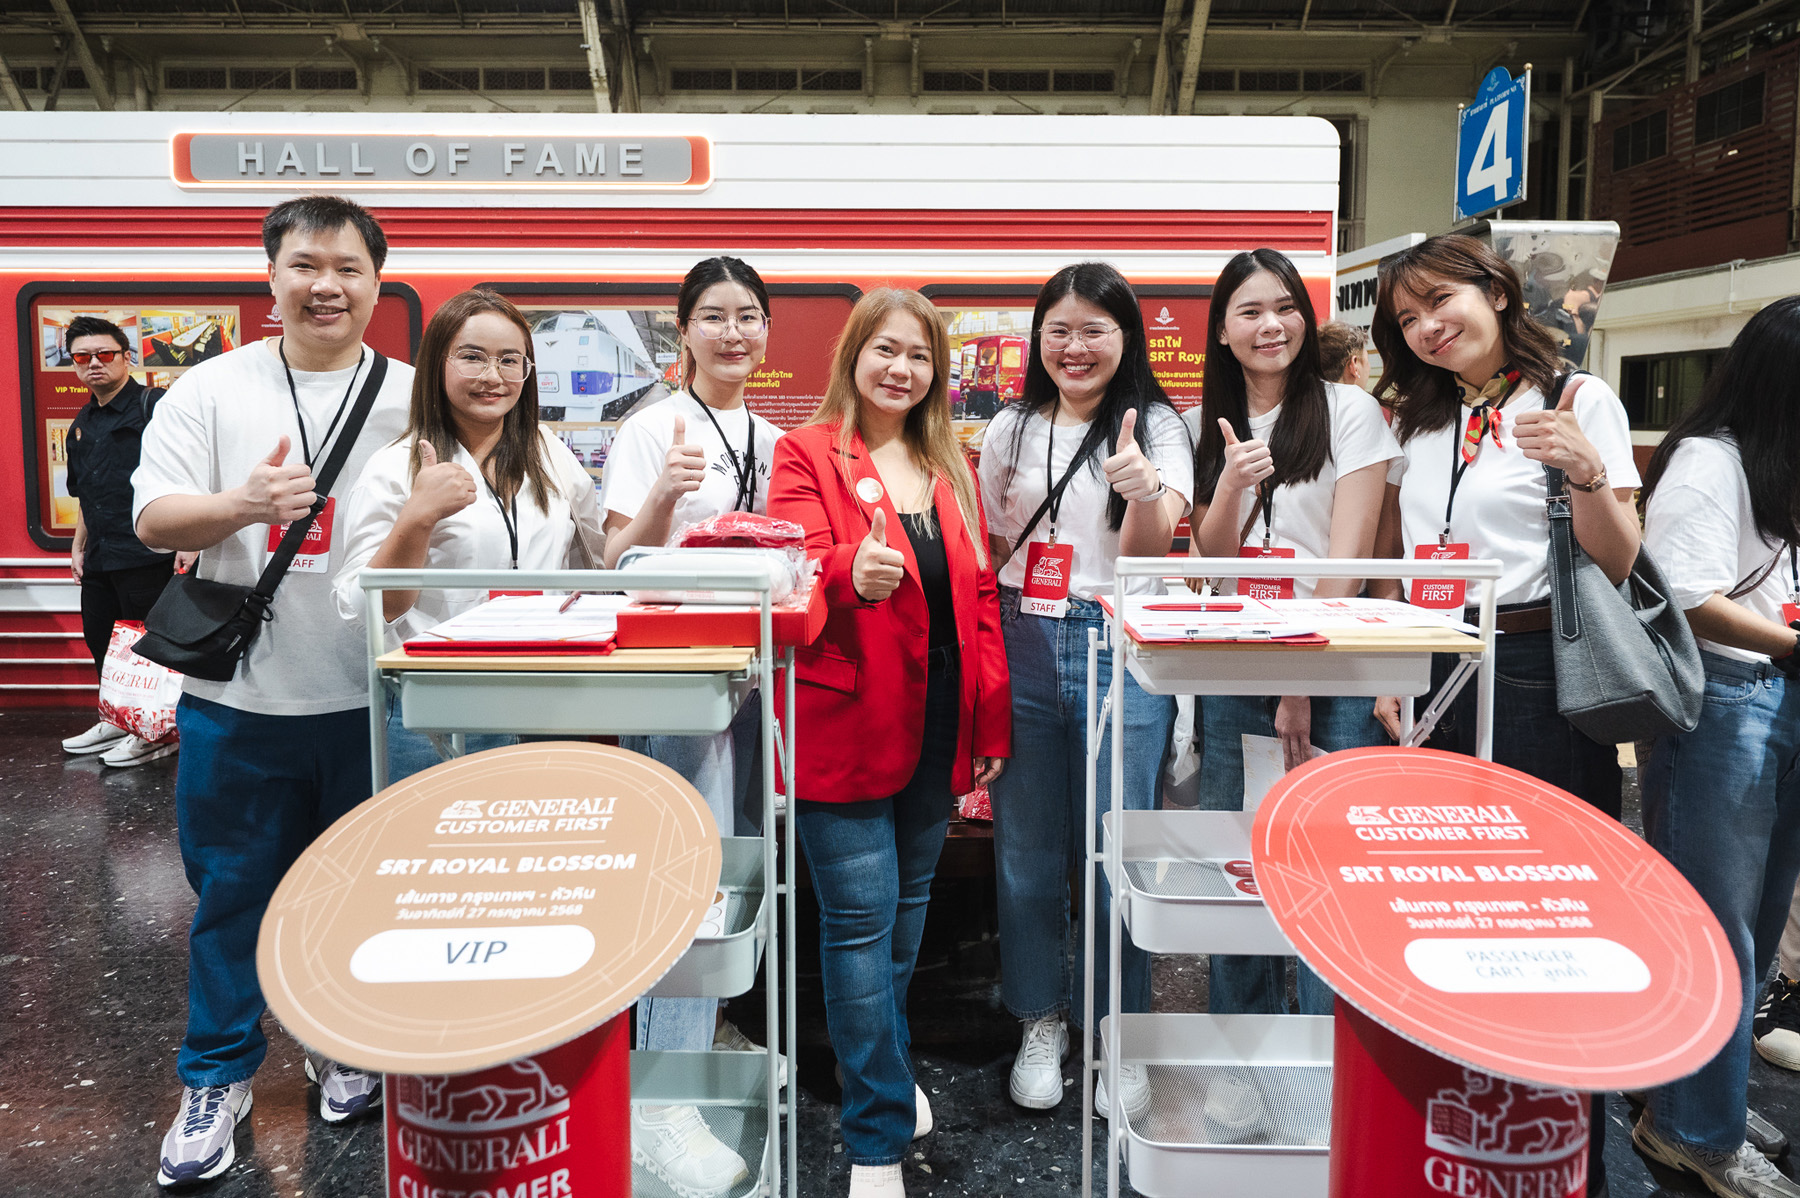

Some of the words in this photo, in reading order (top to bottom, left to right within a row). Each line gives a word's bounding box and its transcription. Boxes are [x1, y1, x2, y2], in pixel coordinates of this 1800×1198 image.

[1467, 100, 1512, 201] 4
[236, 141, 375, 175] HALL
[405, 141, 471, 176] OF
[503, 142, 644, 176] FAME
[1149, 335, 1182, 348] รถไฟ
[1149, 351, 1175, 362] SRT
[55, 386, 68, 394] VIP
[69, 386, 89, 394] Train
[280, 530, 322, 541] GRALI
[1031, 577, 1062, 587] GENERALI
[1250, 583, 1281, 591] CUSTOMER
[1250, 590, 1281, 600] FIRST
[1421, 590, 1455, 601] FIRST
[1030, 602, 1056, 613] STAFF
[487, 797, 618, 818] GENERALI
[1388, 805, 1521, 824] GENERALI
[434, 819, 549, 835] CUSTOMER
[554, 817, 613, 831] FIRST
[1355, 826, 1472, 841] CUSTOMER
[1472, 826, 1530, 840] FIRST
[375, 858, 427, 876] SRT
[428, 857, 510, 875] ROYAL
[516, 853, 637, 873] BLOSSOM
[1339, 865, 1385, 883] SRT
[1389, 865, 1476, 883] ROYAL
[1474, 864, 1599, 882] BLOSSOM
[394, 888, 457, 905] เส้นทาง
[460, 890, 536, 907] กรุงเทพฯ
[549, 886, 596, 901] หัวหิน
[466, 908, 486, 919] 27
[549, 905, 583, 917] 2568
[1389, 896, 1451, 914] เส้นทาง
[1453, 899, 1530, 916] กรุงเทพฯ
[1478, 916, 1494, 929] 27
[1558, 916, 1594, 929] 2568
[446, 940, 508, 965] VIP
[1466, 951, 1576, 963] PASSENGER
[1475, 966, 1525, 979] CAR1
[398, 1116, 571, 1174] GENERALI
